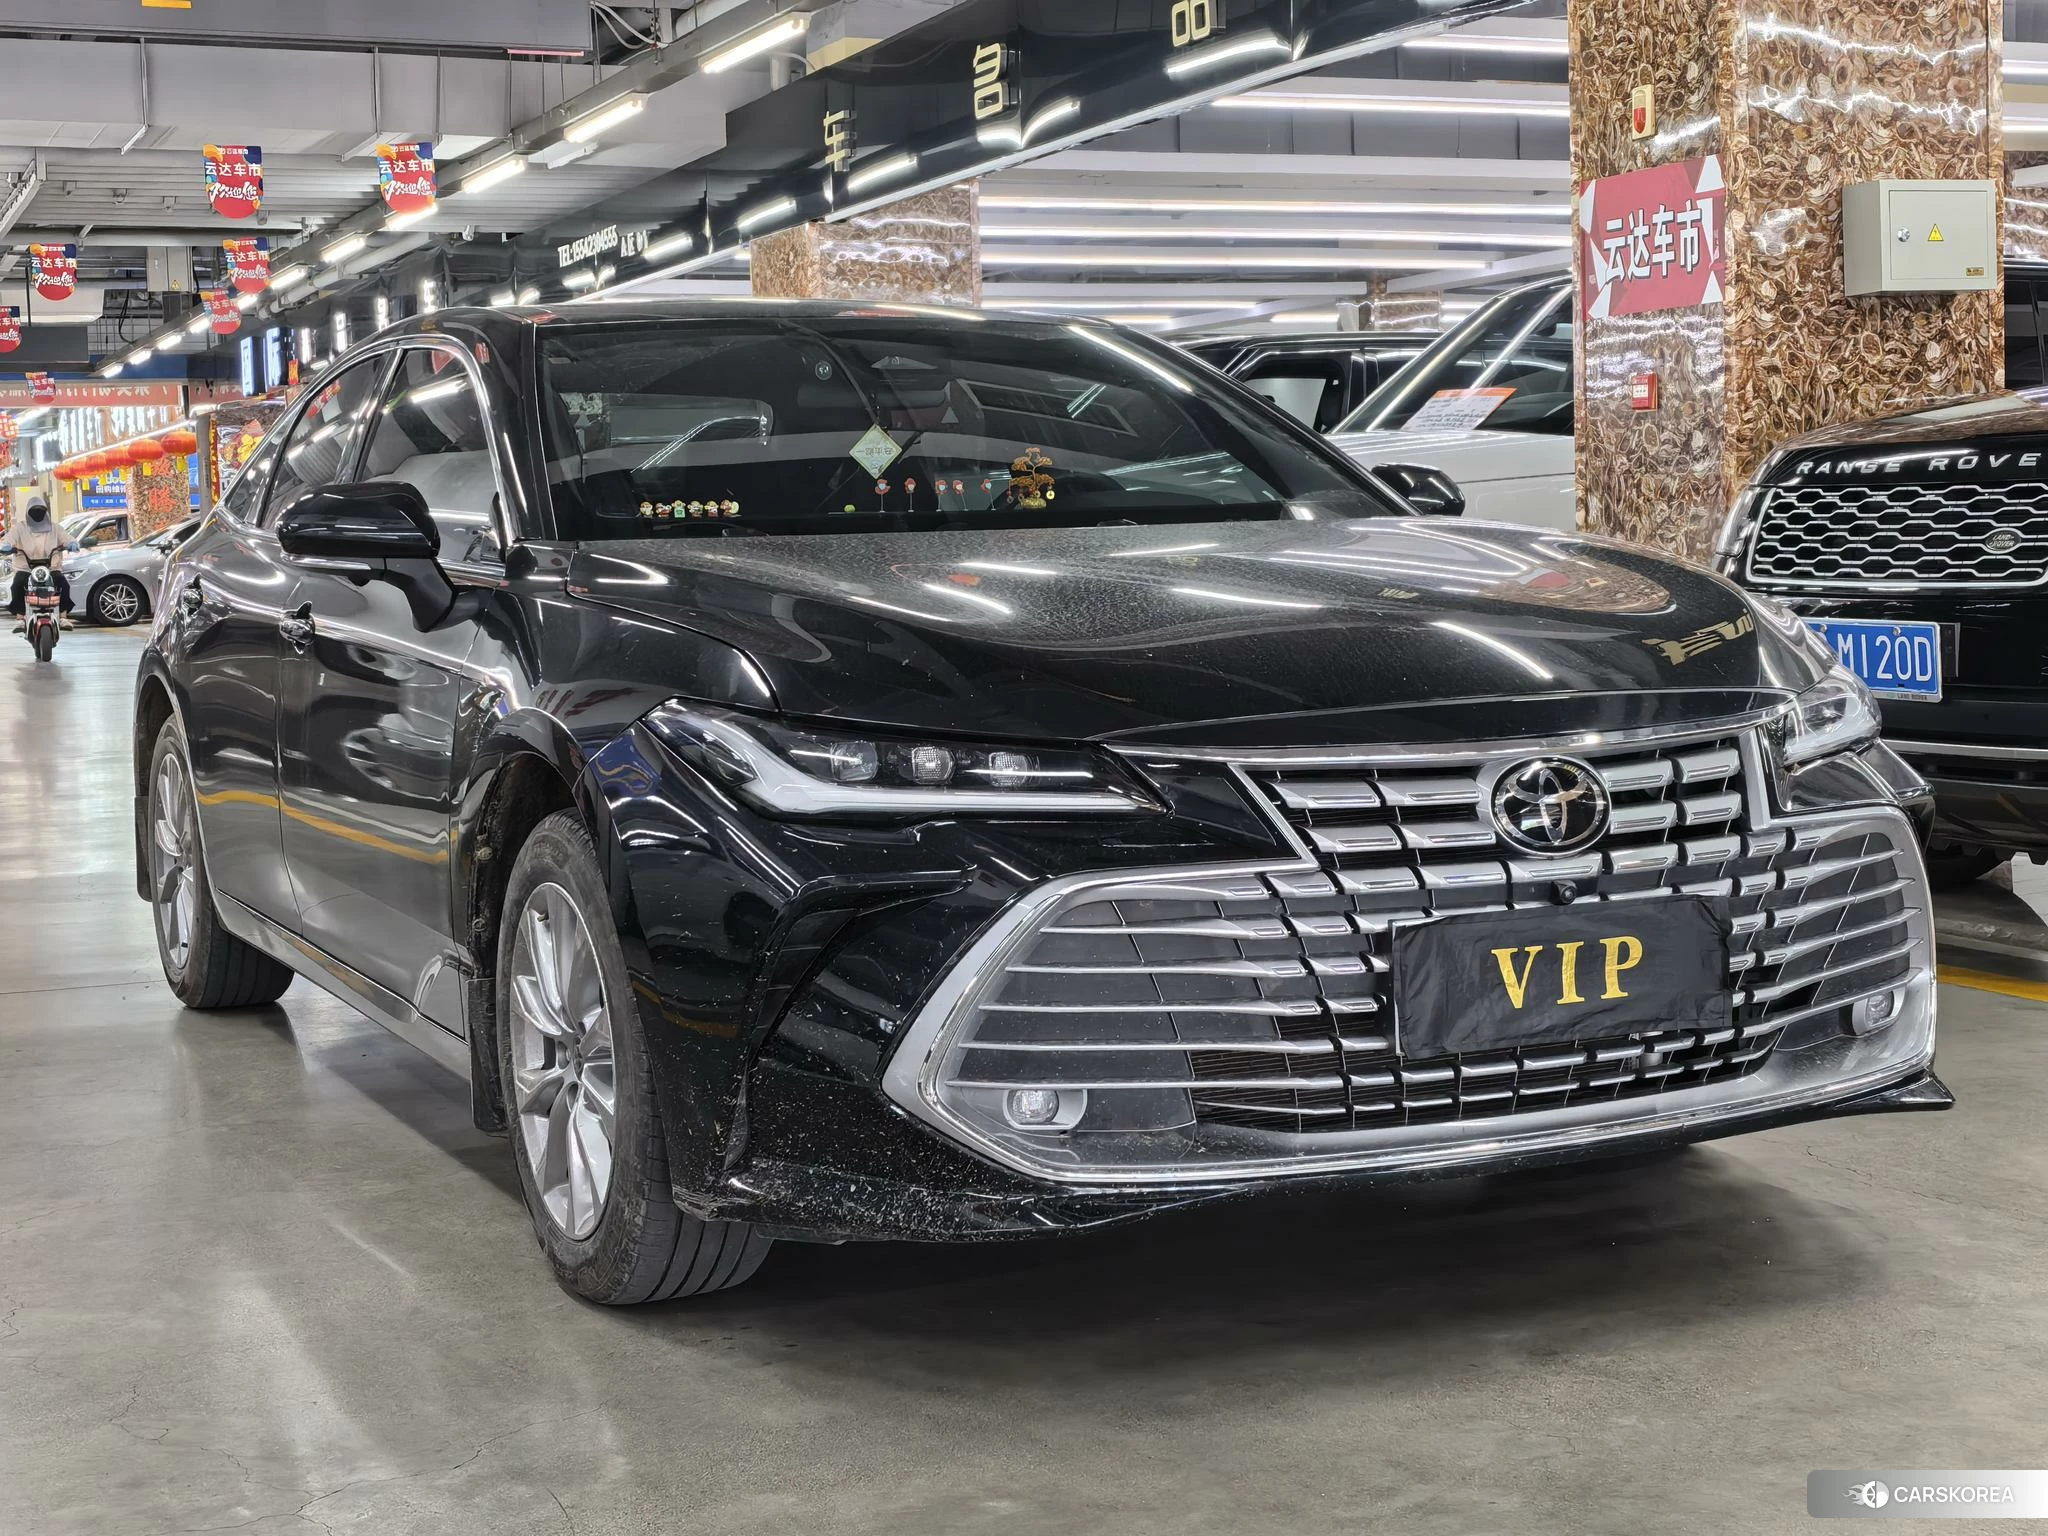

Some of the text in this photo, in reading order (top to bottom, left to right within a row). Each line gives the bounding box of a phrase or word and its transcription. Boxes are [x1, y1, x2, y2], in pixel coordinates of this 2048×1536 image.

[205, 162, 262, 176] 云达车市
[379, 159, 433, 174] 云达车市
[1603, 199, 1702, 281] 云达车市
[31, 257, 77, 268] 云达车市
[225, 251, 269, 263] 云达车市
[1796, 452, 2042, 475] RANGE ROVE
[1814, 631, 1933, 682] M120D
[1491, 935, 1643, 1009] VIP
